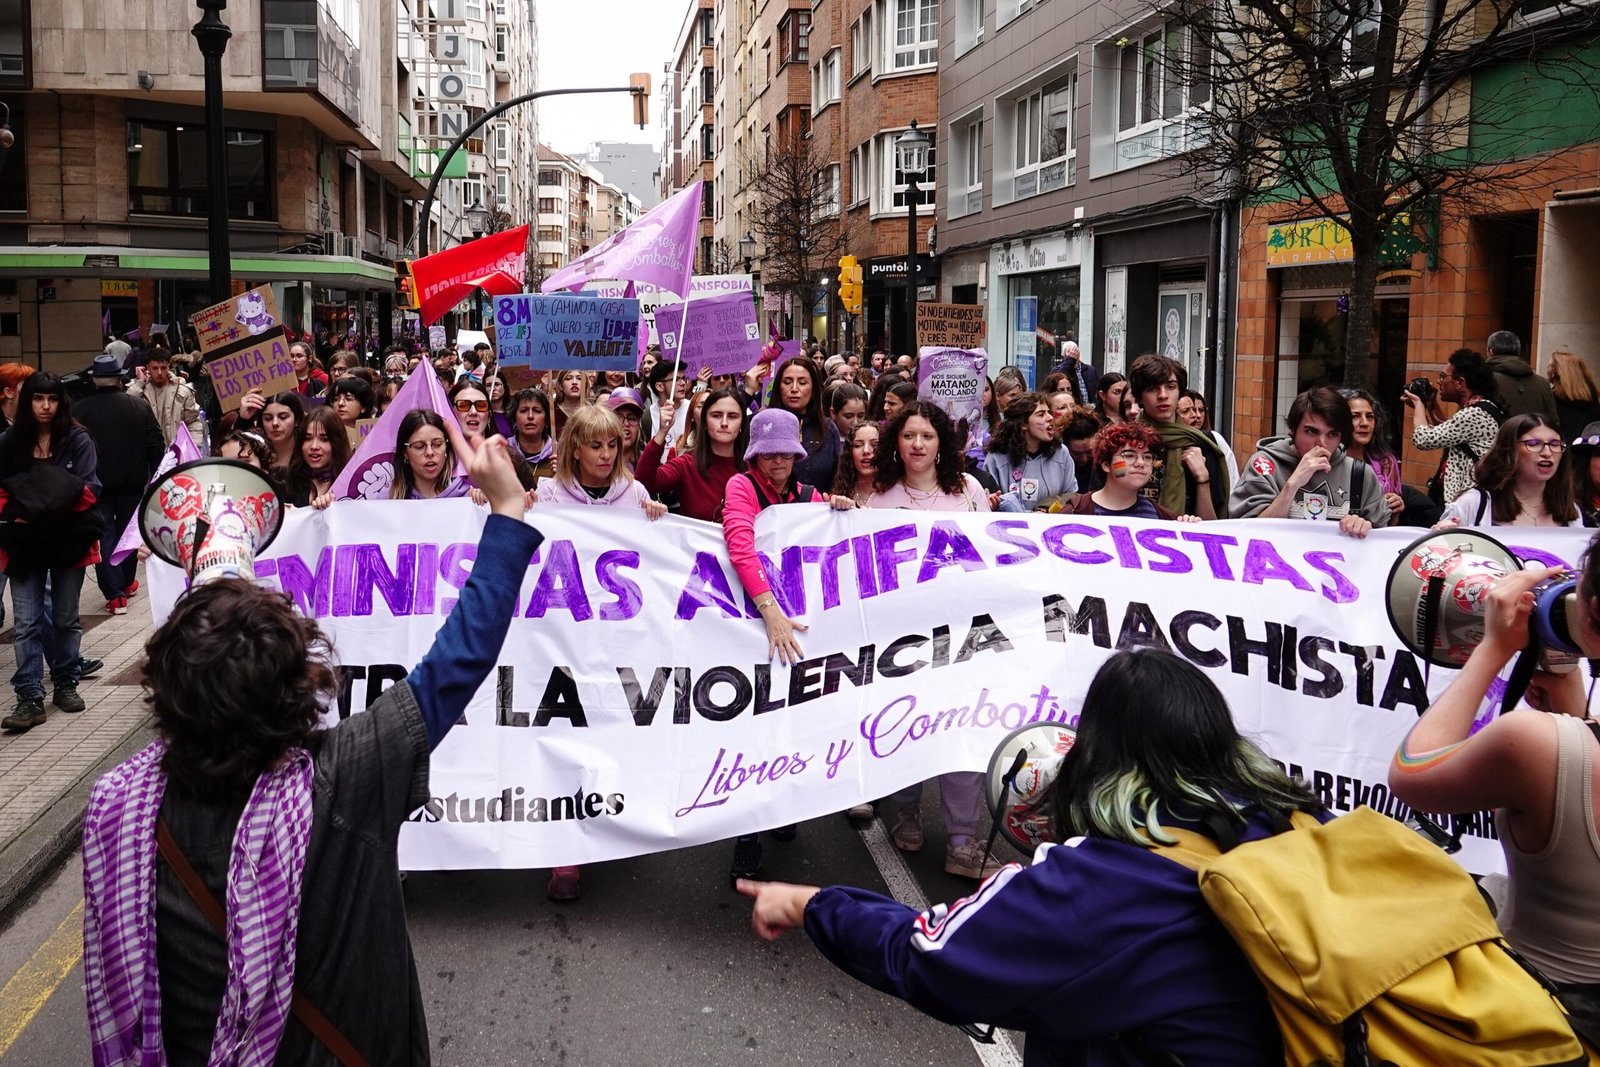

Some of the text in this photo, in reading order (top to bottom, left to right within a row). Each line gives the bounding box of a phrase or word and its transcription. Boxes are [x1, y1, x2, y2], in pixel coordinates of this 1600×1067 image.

[689, 280, 751, 292] ANSFOBIA
[497, 298, 532, 326] 8M
[534, 300, 547, 316] DE
[552, 298, 587, 316] CAMINO
[600, 301, 625, 316] CASA
[918, 305, 926, 317] SI
[927, 306, 938, 318] NO
[938, 307, 973, 320] ENTIENDES
[545, 319, 581, 335] QUIERO
[584, 322, 600, 334] SER
[918, 320, 947, 332] MOTIVOS
[959, 321, 981, 334] HUELGA
[928, 333, 975, 343] ERES PARTE
[540, 341, 558, 356] NO
[210, 341, 285, 380] EDUCA A
[216, 375, 242, 399] LOS
[931, 379, 978, 389] MATANDO
[936, 388, 977, 397] VIOLANDO
[674, 519, 1361, 621] ANTIFASCISTAS
[496, 665, 589, 728] LA
[616, 613, 1014, 727] VIOLENCIA
[1042, 593, 1430, 718] MACHISTA
[675, 748, 815, 818] Libres
[825, 739, 854, 780] y
